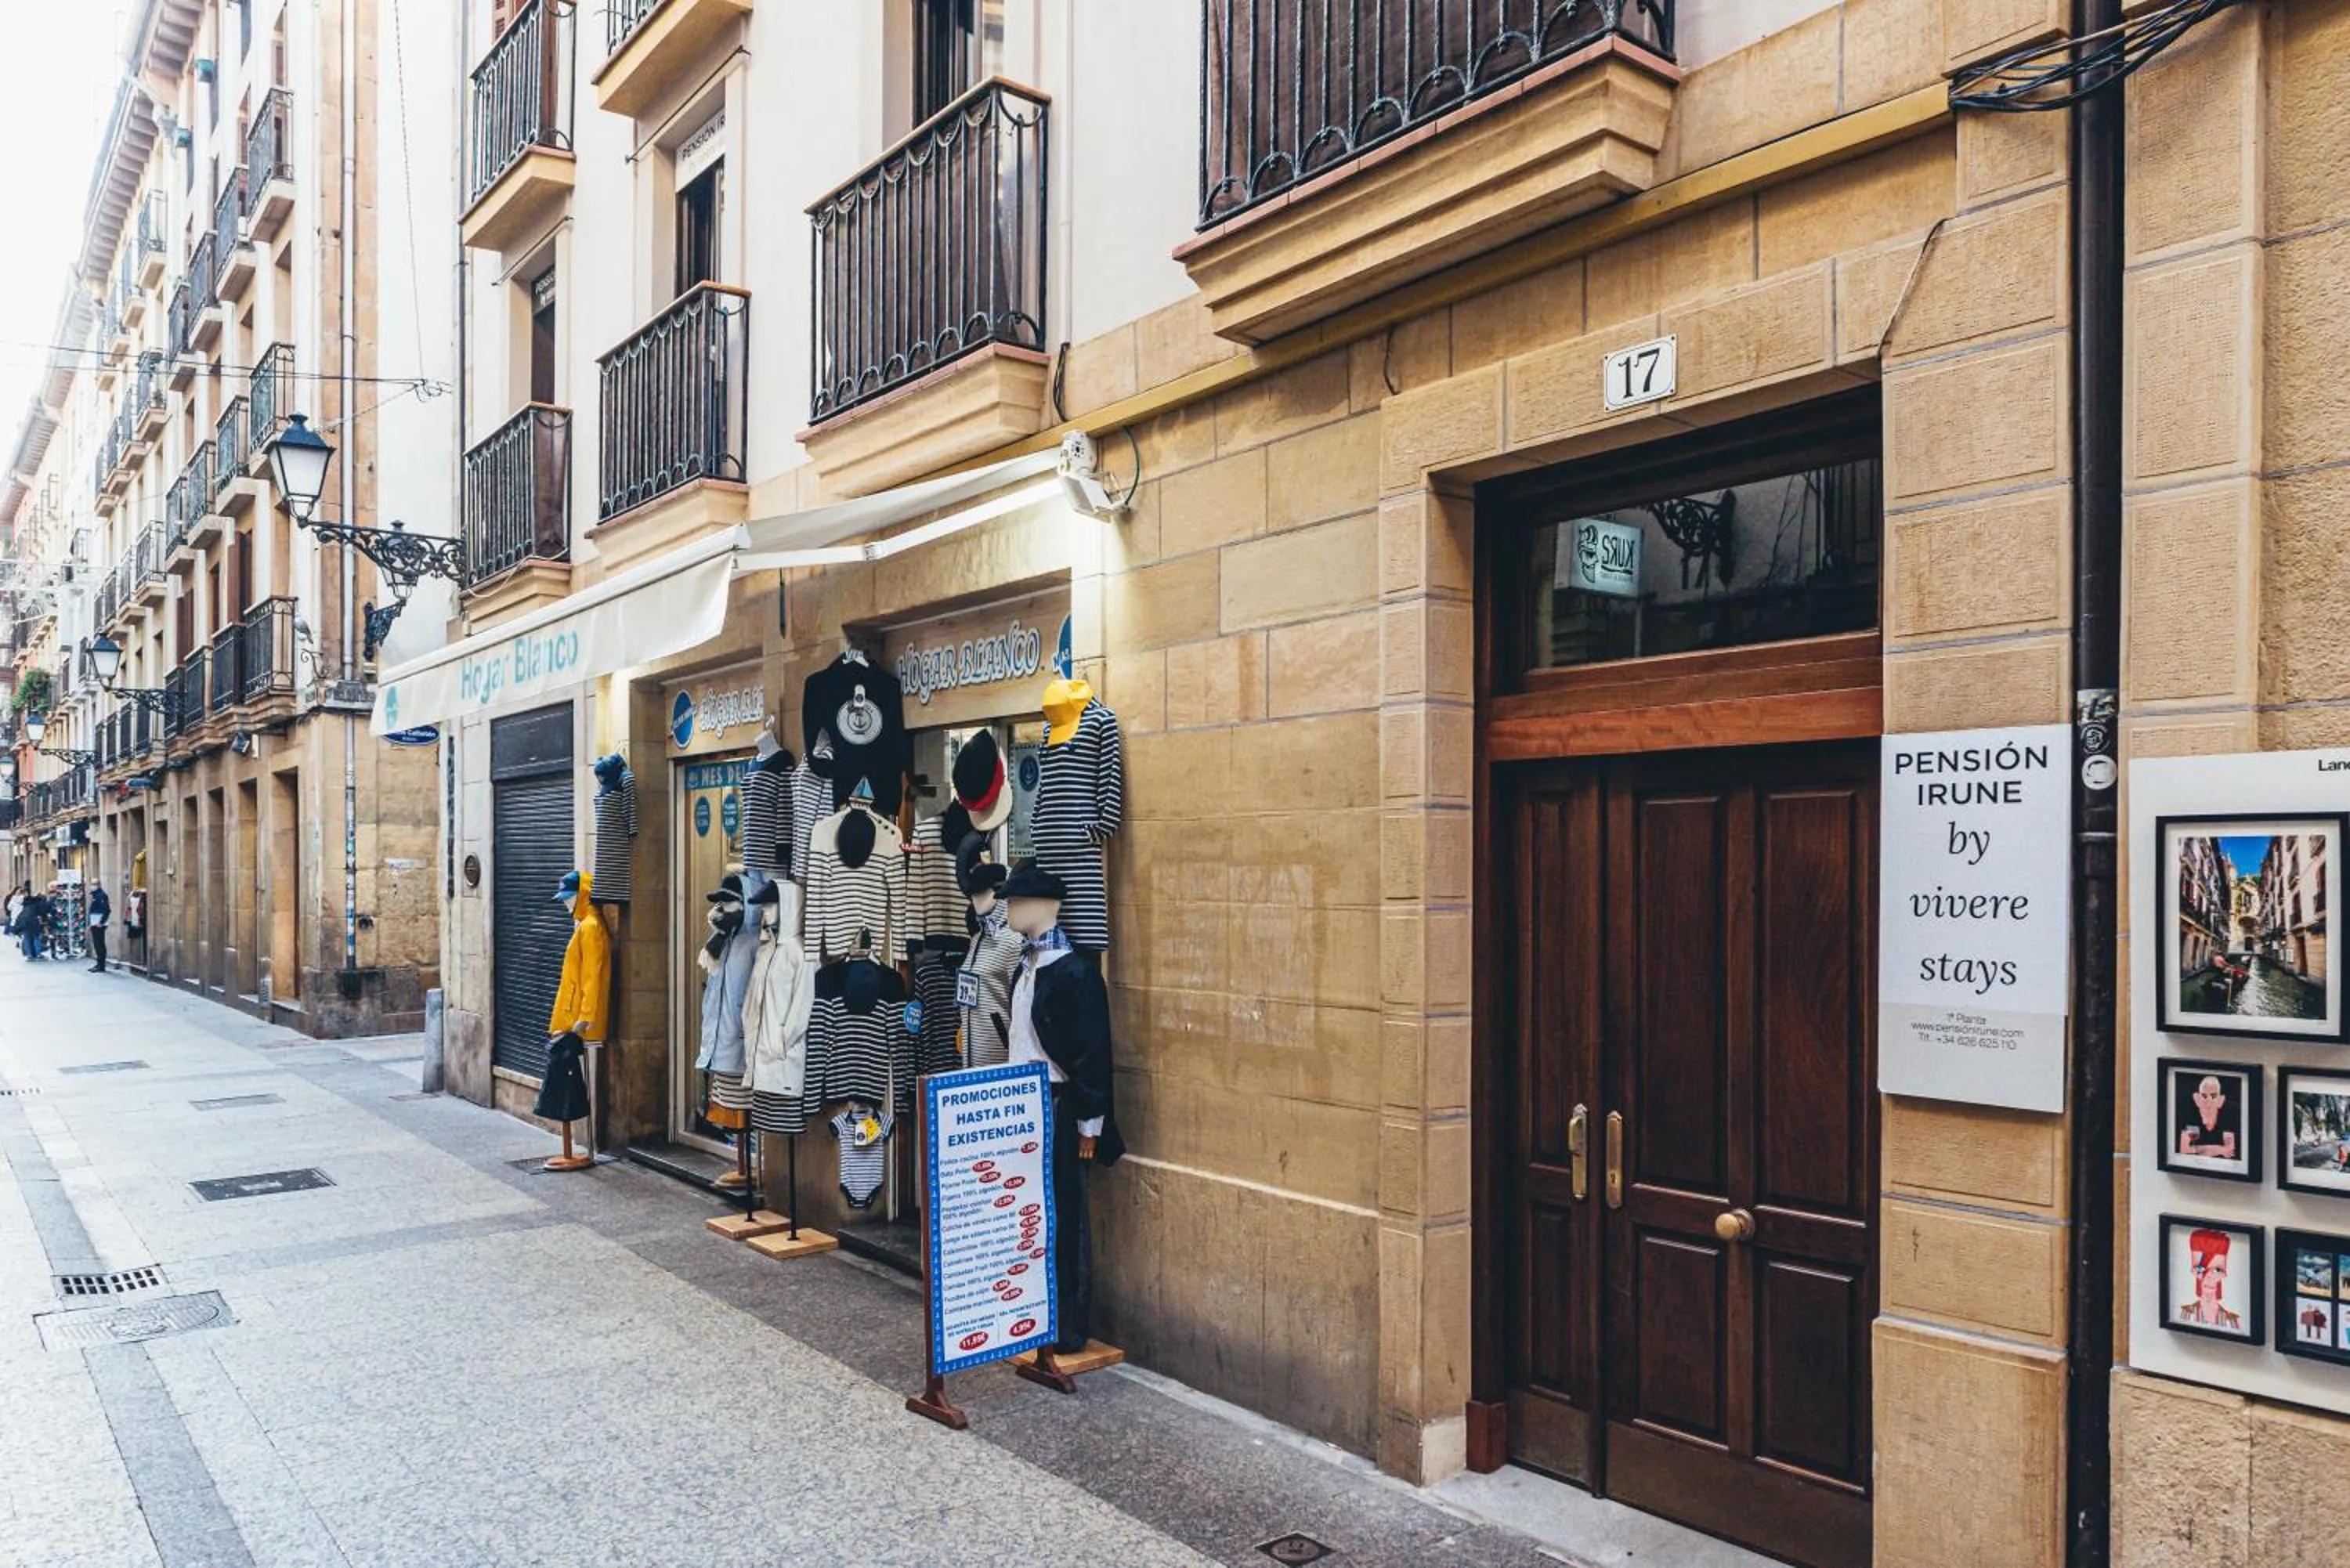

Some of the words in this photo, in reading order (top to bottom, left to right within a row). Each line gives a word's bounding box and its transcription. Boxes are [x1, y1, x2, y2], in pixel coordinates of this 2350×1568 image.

[1617, 347, 1661, 399] 17
[461, 653, 509, 703] Hogar
[514, 630, 578, 684] Blanco
[960, 620, 1041, 685] BLANCO
[1895, 741, 2048, 775] PENSIÓN
[1918, 781, 2023, 807] IRUNE
[1948, 821, 1991, 865] by
[1909, 886, 2029, 919] vivere
[1919, 953, 2018, 995] stays
[942, 1082, 1037, 1107] PROMOCIONES
[956, 1107, 1000, 1125] HASTA
[1004, 1104, 1025, 1118] FIN
[949, 1122, 1035, 1147] EXISTENCIAS
